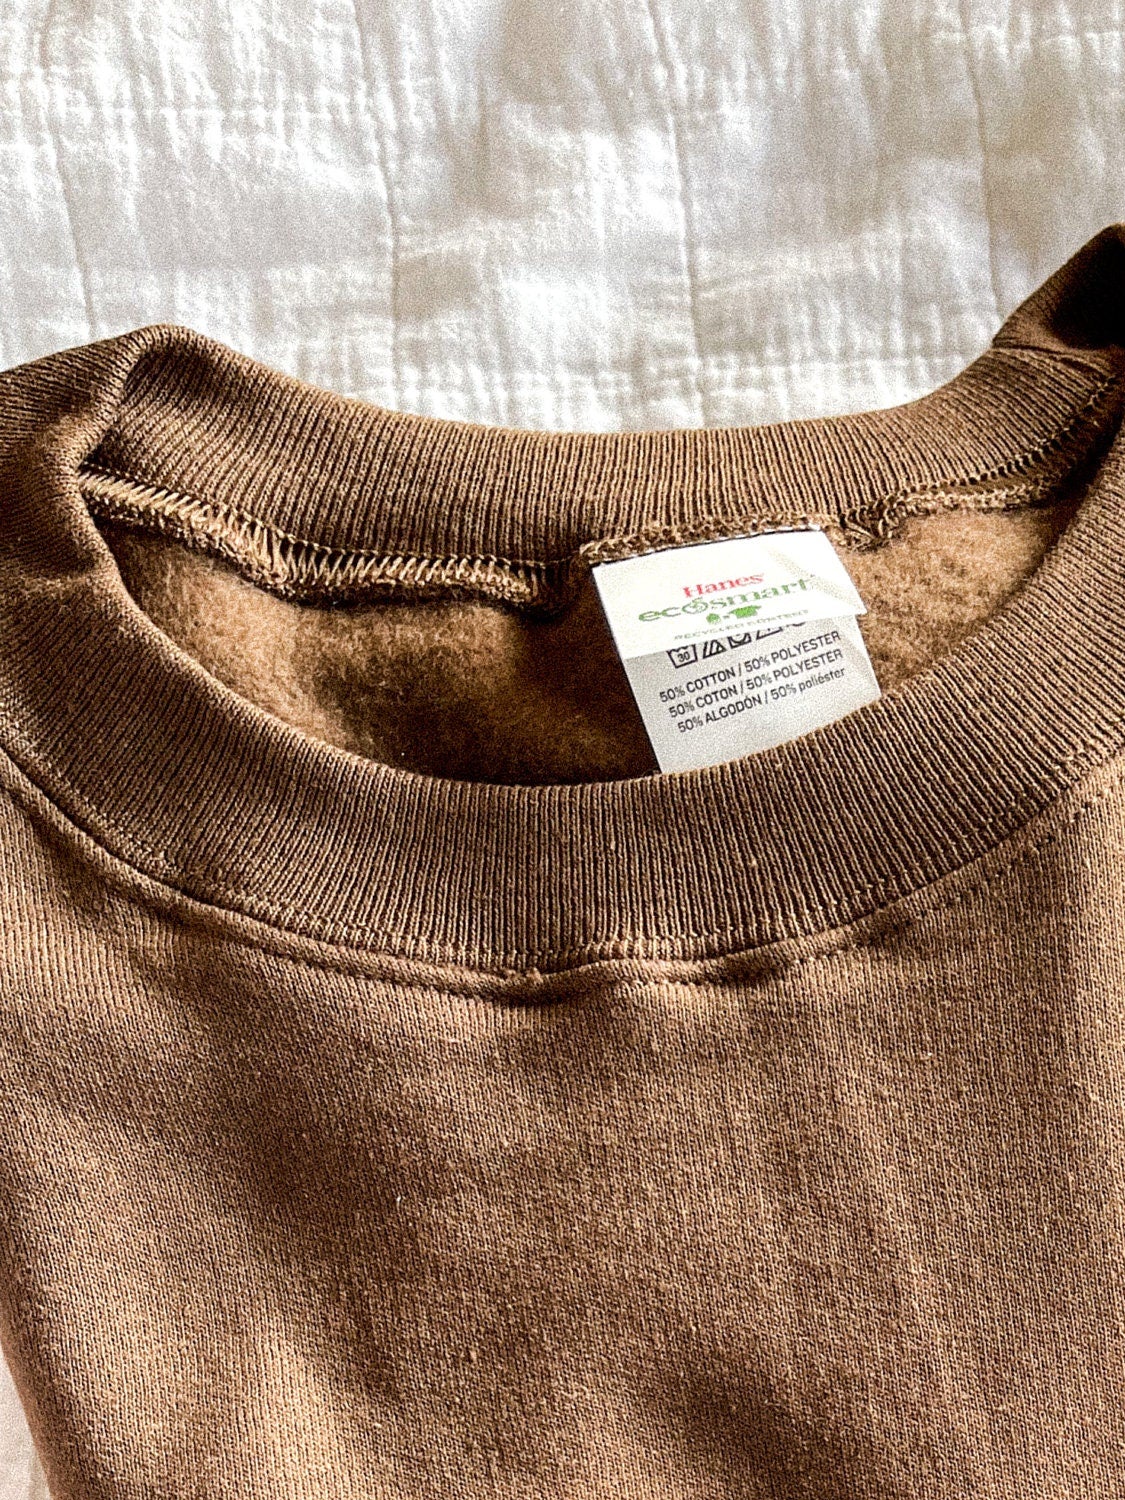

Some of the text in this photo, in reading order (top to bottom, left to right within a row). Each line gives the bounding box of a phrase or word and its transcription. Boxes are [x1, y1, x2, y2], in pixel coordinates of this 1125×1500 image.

[683, 573, 764, 598] Hanes
[659, 684, 686, 703] 50%
[686, 666, 736, 693] COTTON
[744, 655, 771, 673] 50%
[770, 630, 841, 664] POLYESTER
[668, 701, 695, 718] 50%
[695, 684, 738, 708] COTON
[746, 672, 773, 690] 50%
[773, 648, 844, 681] POLYESTER
[677, 651, 690, 663] 30
[677, 715, 704, 733] 50%
[770, 682, 797, 701] 50%
[798, 667, 845, 693] poliéster
